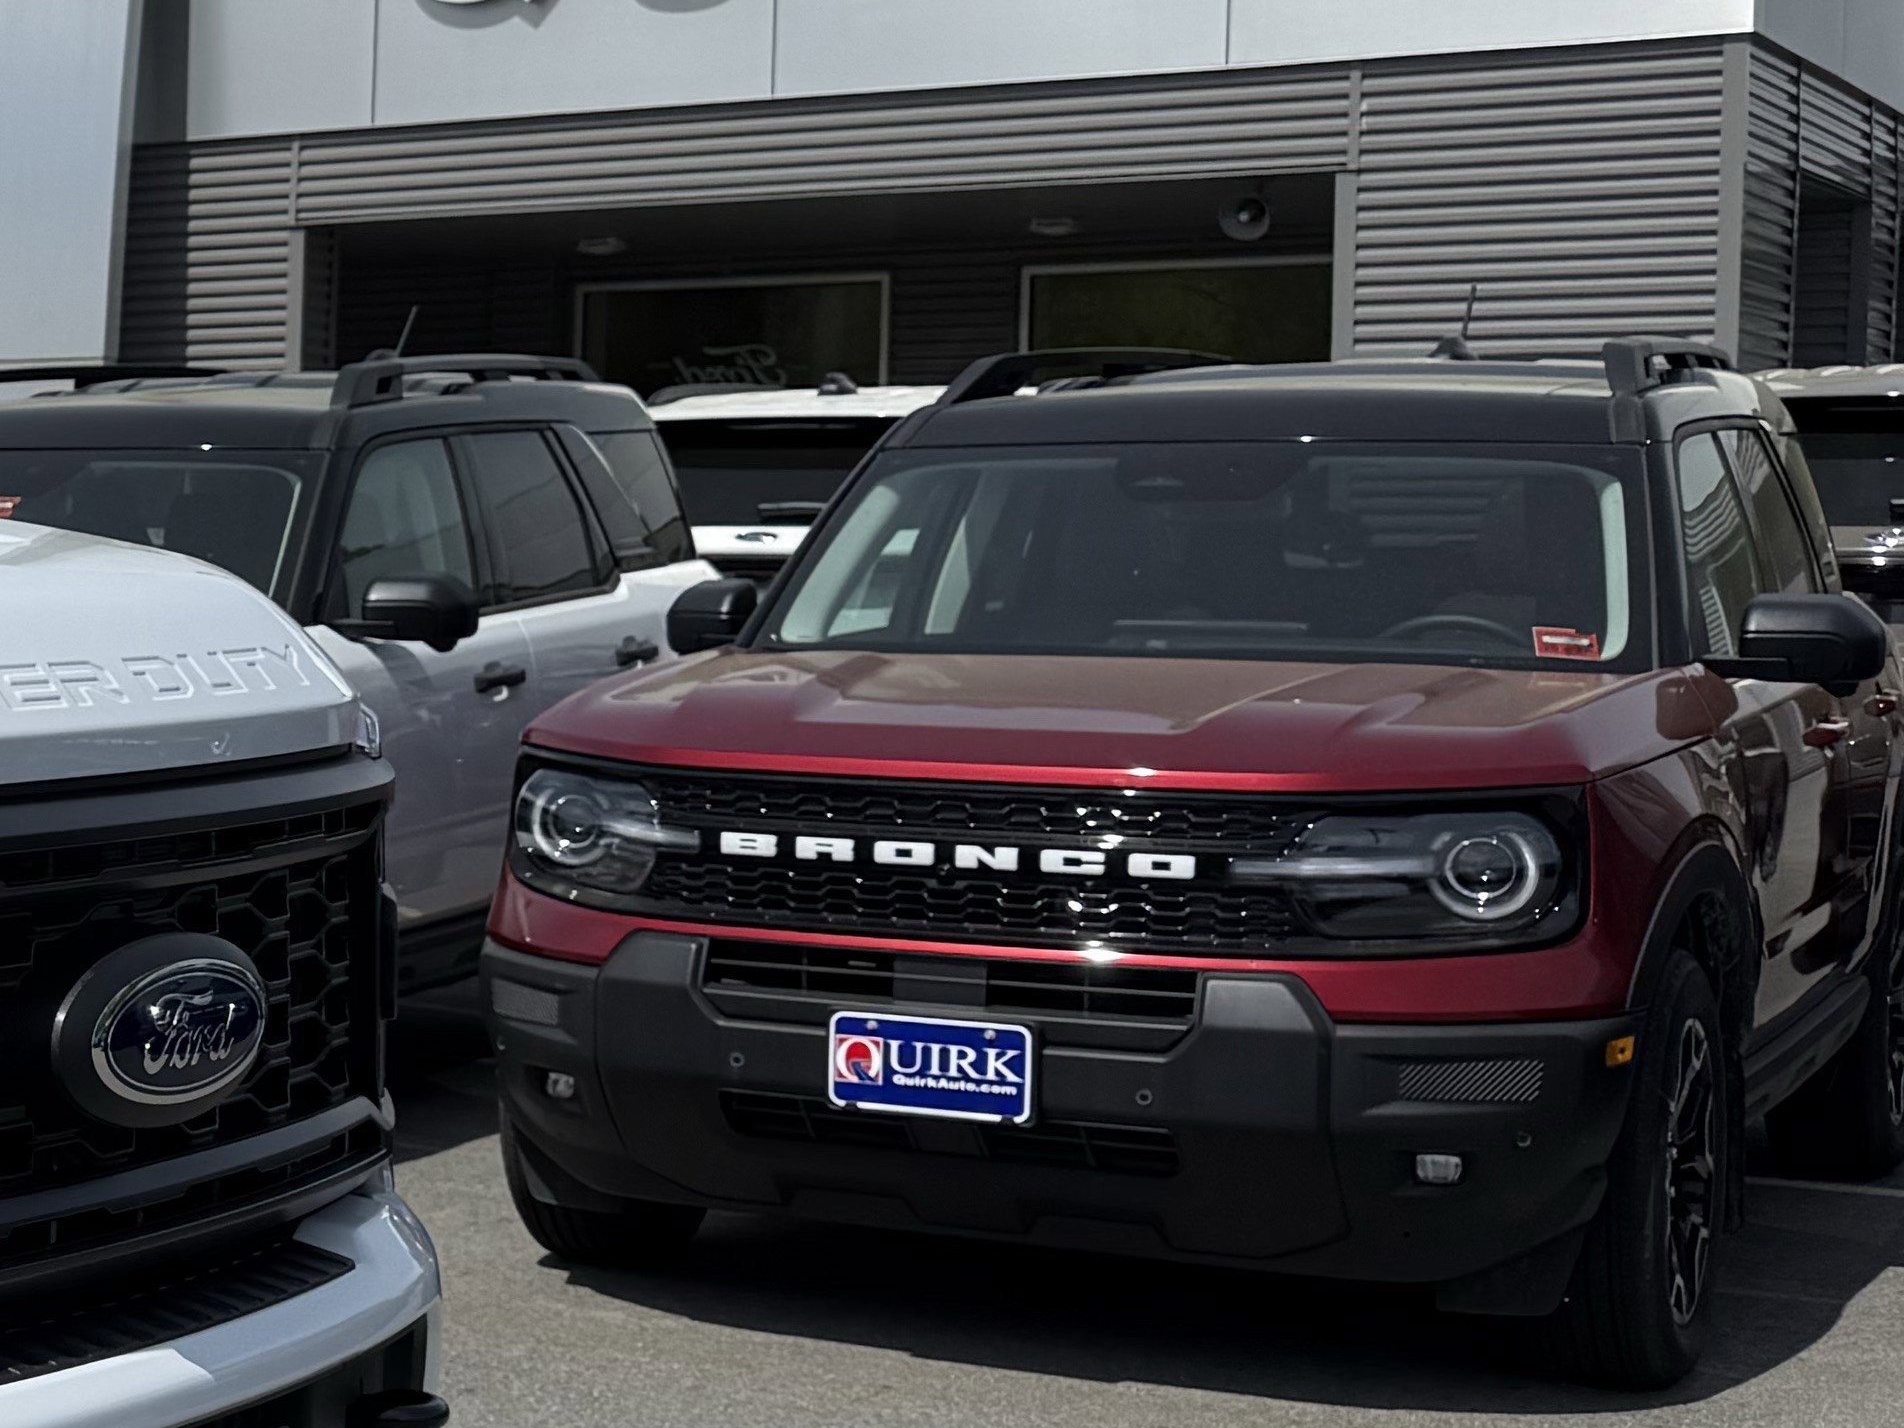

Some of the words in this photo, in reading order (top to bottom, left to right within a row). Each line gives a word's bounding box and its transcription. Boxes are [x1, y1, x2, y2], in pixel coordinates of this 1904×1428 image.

[121, 642, 311, 701] DUTY
[720, 831, 1196, 880] BRONCO
[143, 989, 235, 1076] Ford
[835, 1037, 1024, 1085] QUIRK
[892, 1074, 1018, 1097] QuirkAuto.com
